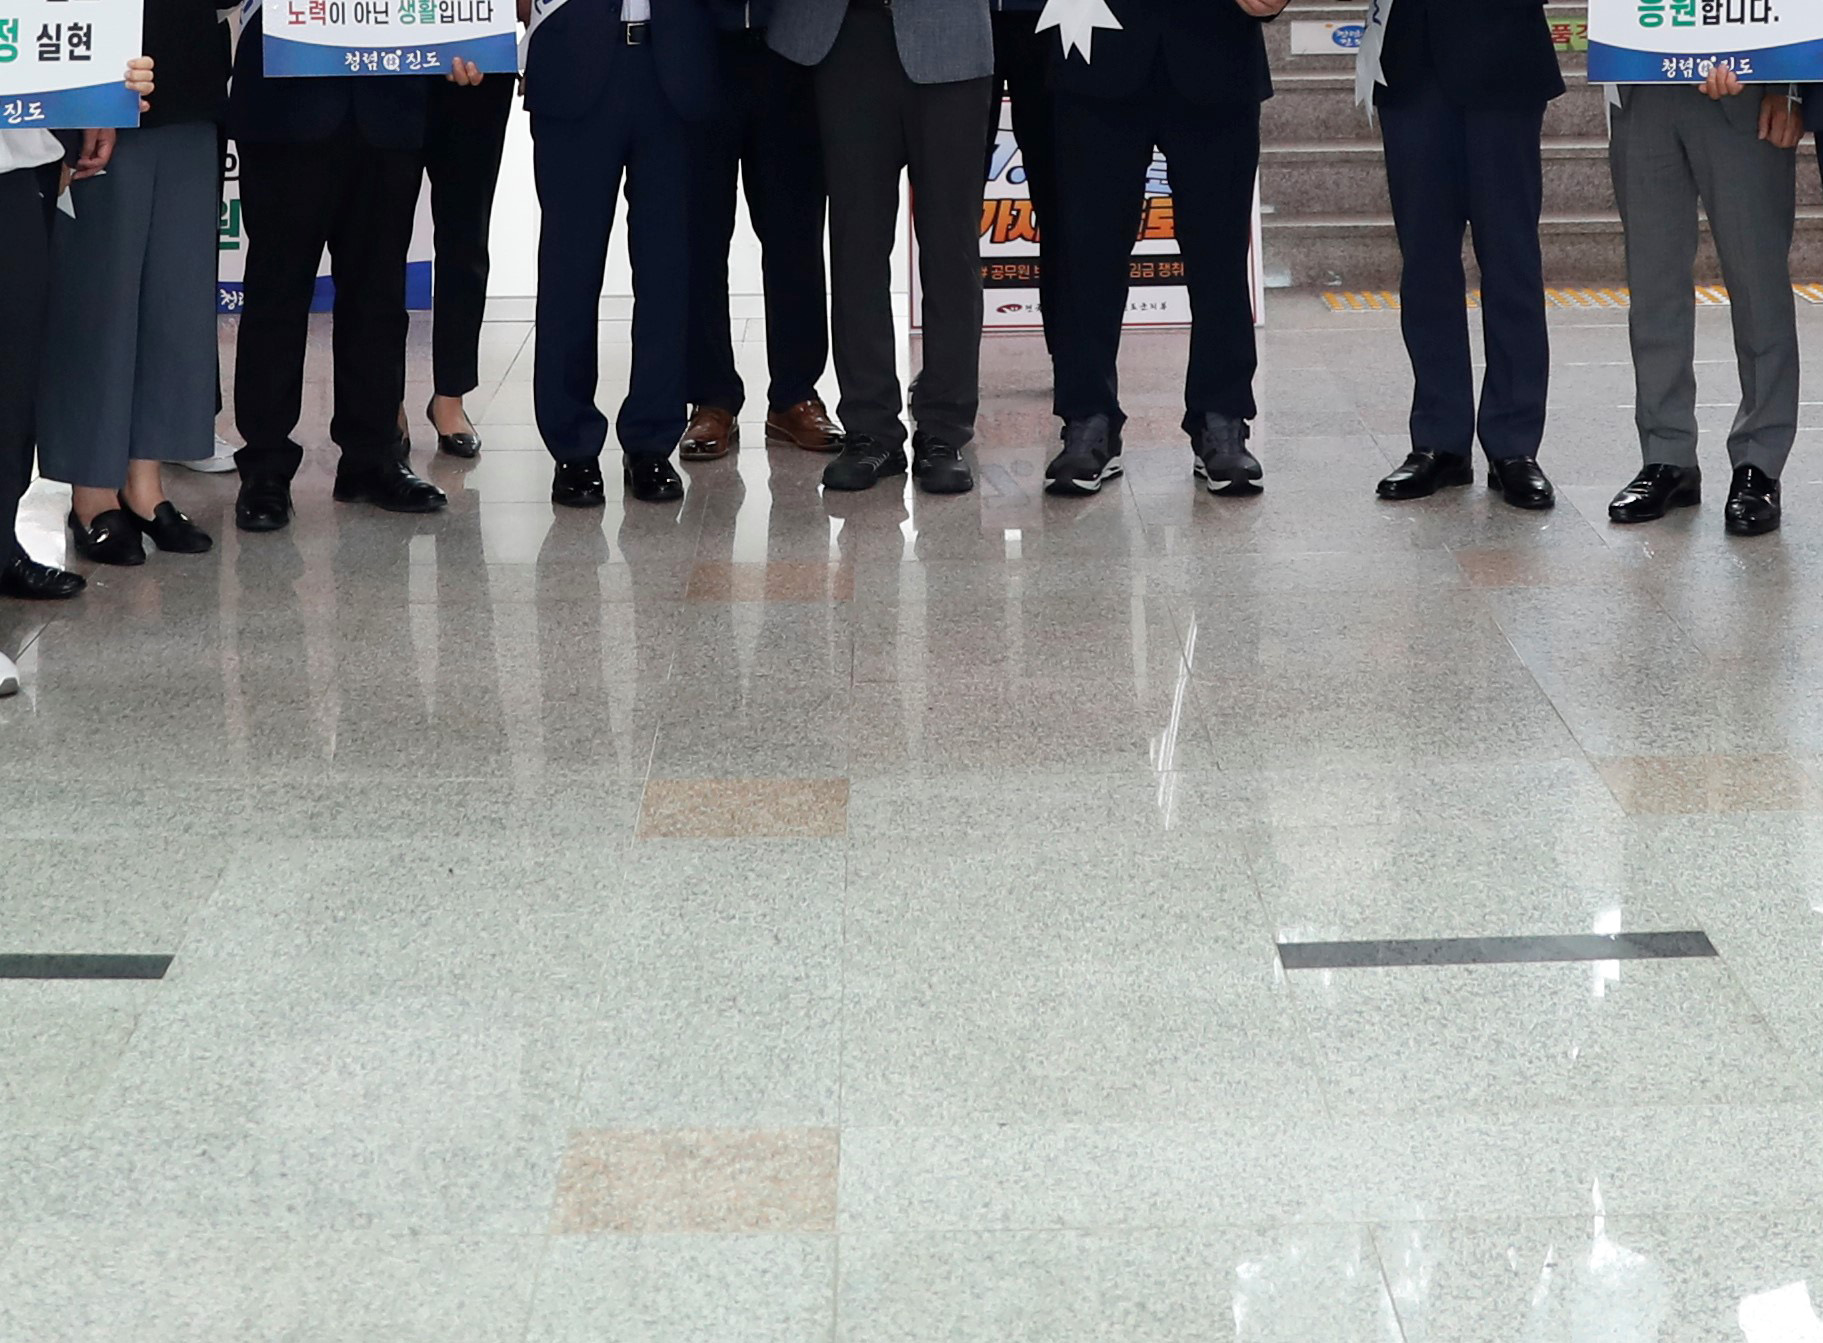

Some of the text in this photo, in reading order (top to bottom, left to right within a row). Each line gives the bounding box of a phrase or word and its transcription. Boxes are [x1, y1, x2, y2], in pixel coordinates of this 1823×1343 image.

[288, 0, 346, 25] 노력이
[354, 0, 389, 25] 아닌
[36, 22, 92, 62] 실현
[991, 264, 1030, 281] 공무원
[1159, 262, 1184, 278] 쟁취
